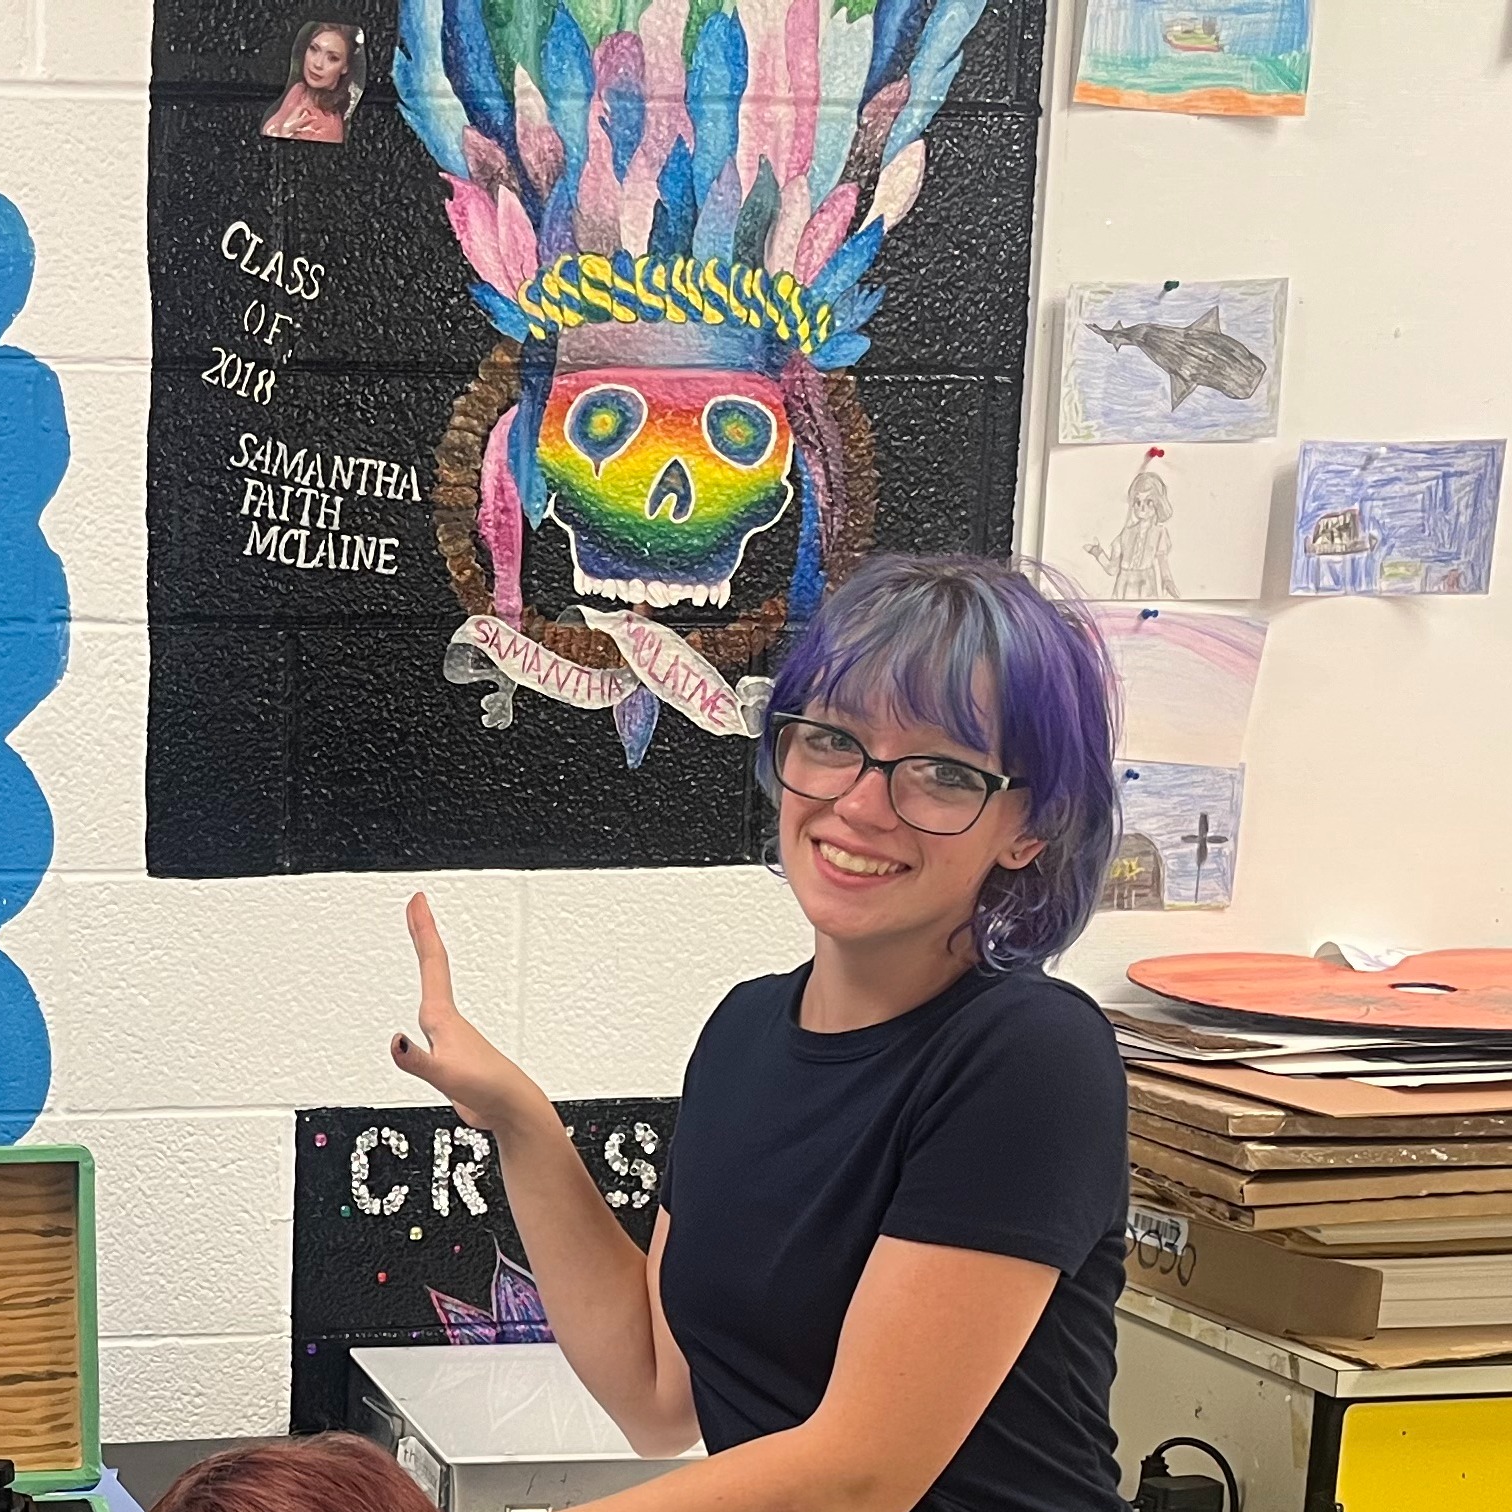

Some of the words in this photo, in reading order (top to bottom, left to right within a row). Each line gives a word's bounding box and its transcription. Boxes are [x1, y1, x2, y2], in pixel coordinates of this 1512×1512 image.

[220, 220, 326, 300] CLASS
[242, 300, 293, 346] OF
[201, 347, 276, 406] 2018
[229, 432, 422, 502] SAMANTHA
[240, 478, 343, 531] FAITH
[243, 521, 399, 575] MCLAINE
[473, 619, 624, 701] SAMANTHA
